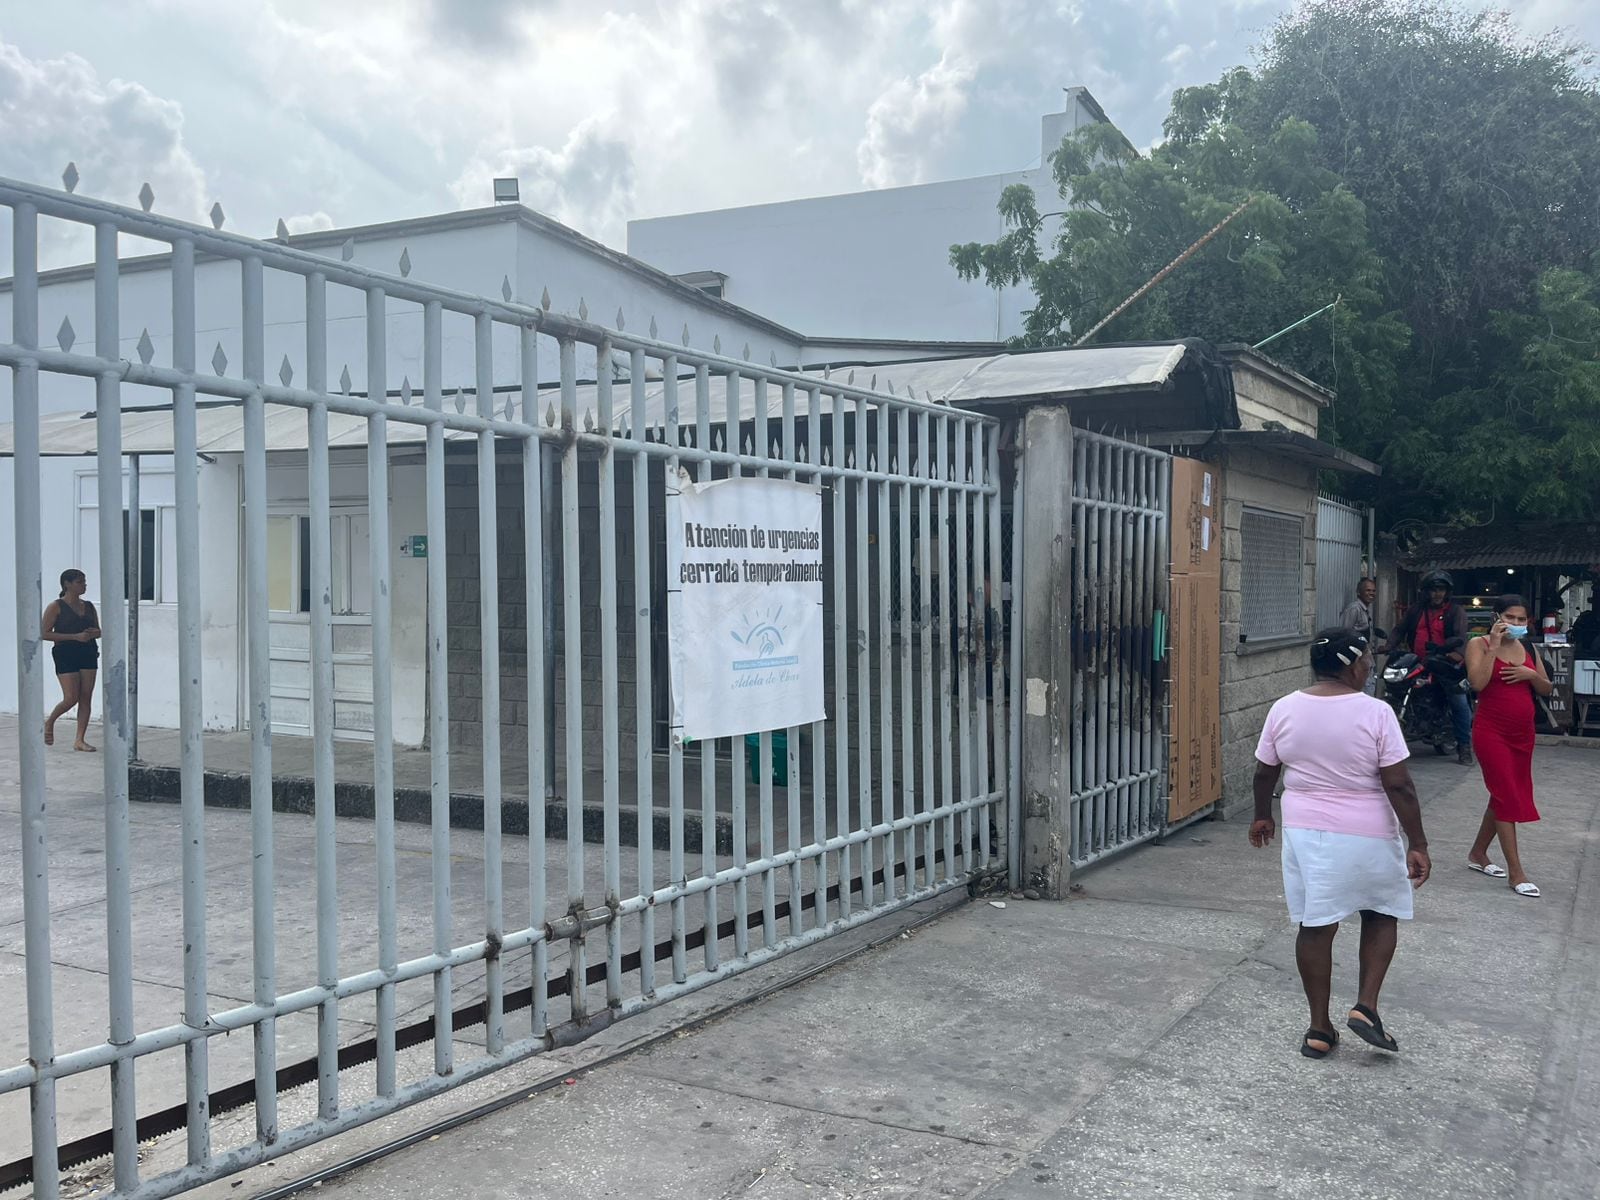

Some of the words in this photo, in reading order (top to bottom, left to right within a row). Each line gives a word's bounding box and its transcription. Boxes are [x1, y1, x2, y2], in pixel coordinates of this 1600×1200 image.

[750, 525, 765, 549] de
[768, 528, 819, 552] urgencias
[680, 559, 739, 583] cerrada
[742, 559, 823, 586] temporalmente
